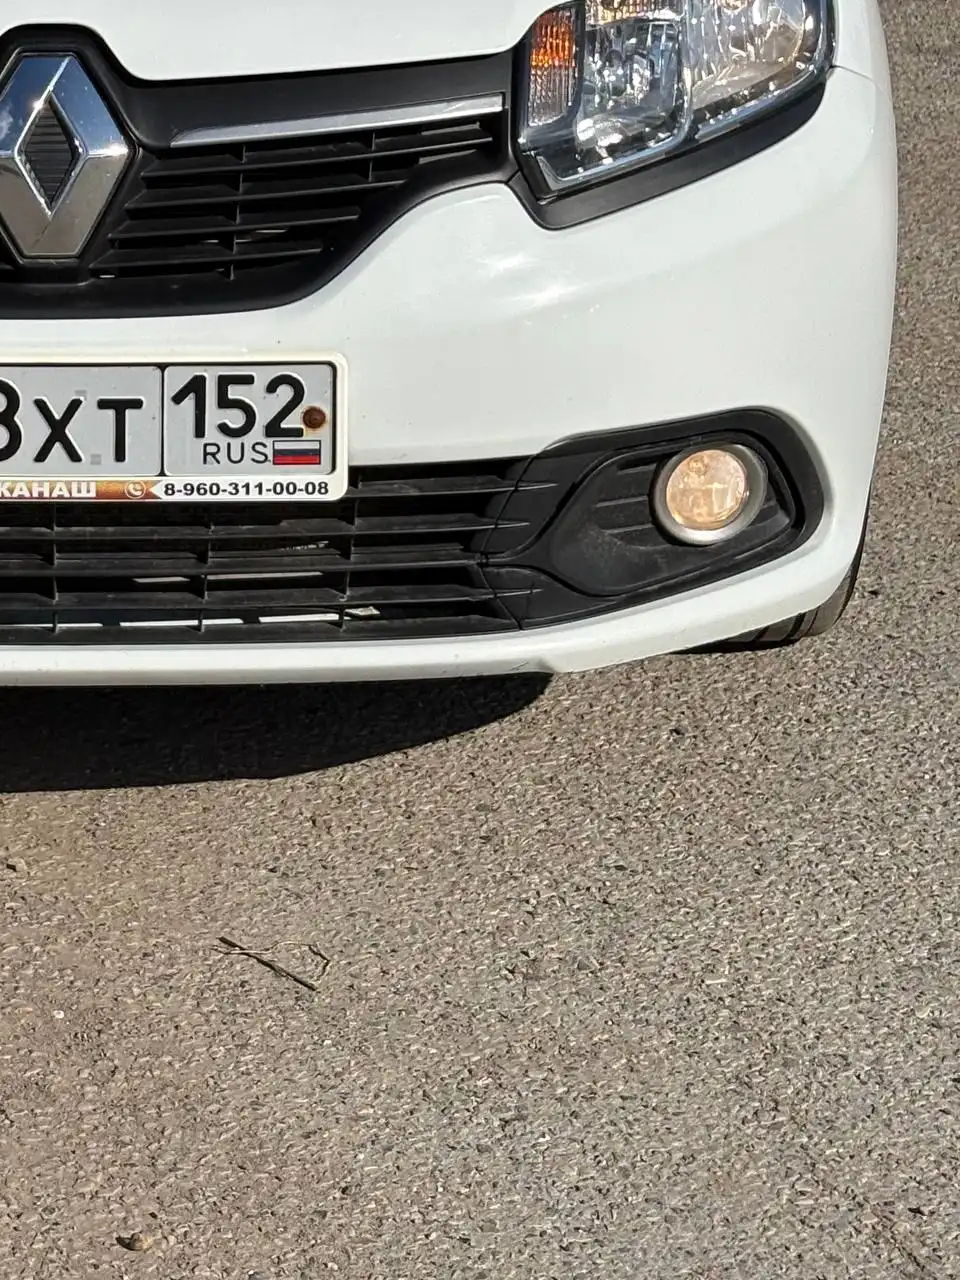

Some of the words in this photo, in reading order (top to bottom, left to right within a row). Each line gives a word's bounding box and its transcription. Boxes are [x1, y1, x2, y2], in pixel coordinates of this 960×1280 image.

[170, 374, 306, 439] 152
[202, 442, 269, 464] RUS
[163, 481, 329, 497] 8-960-311-00-08
